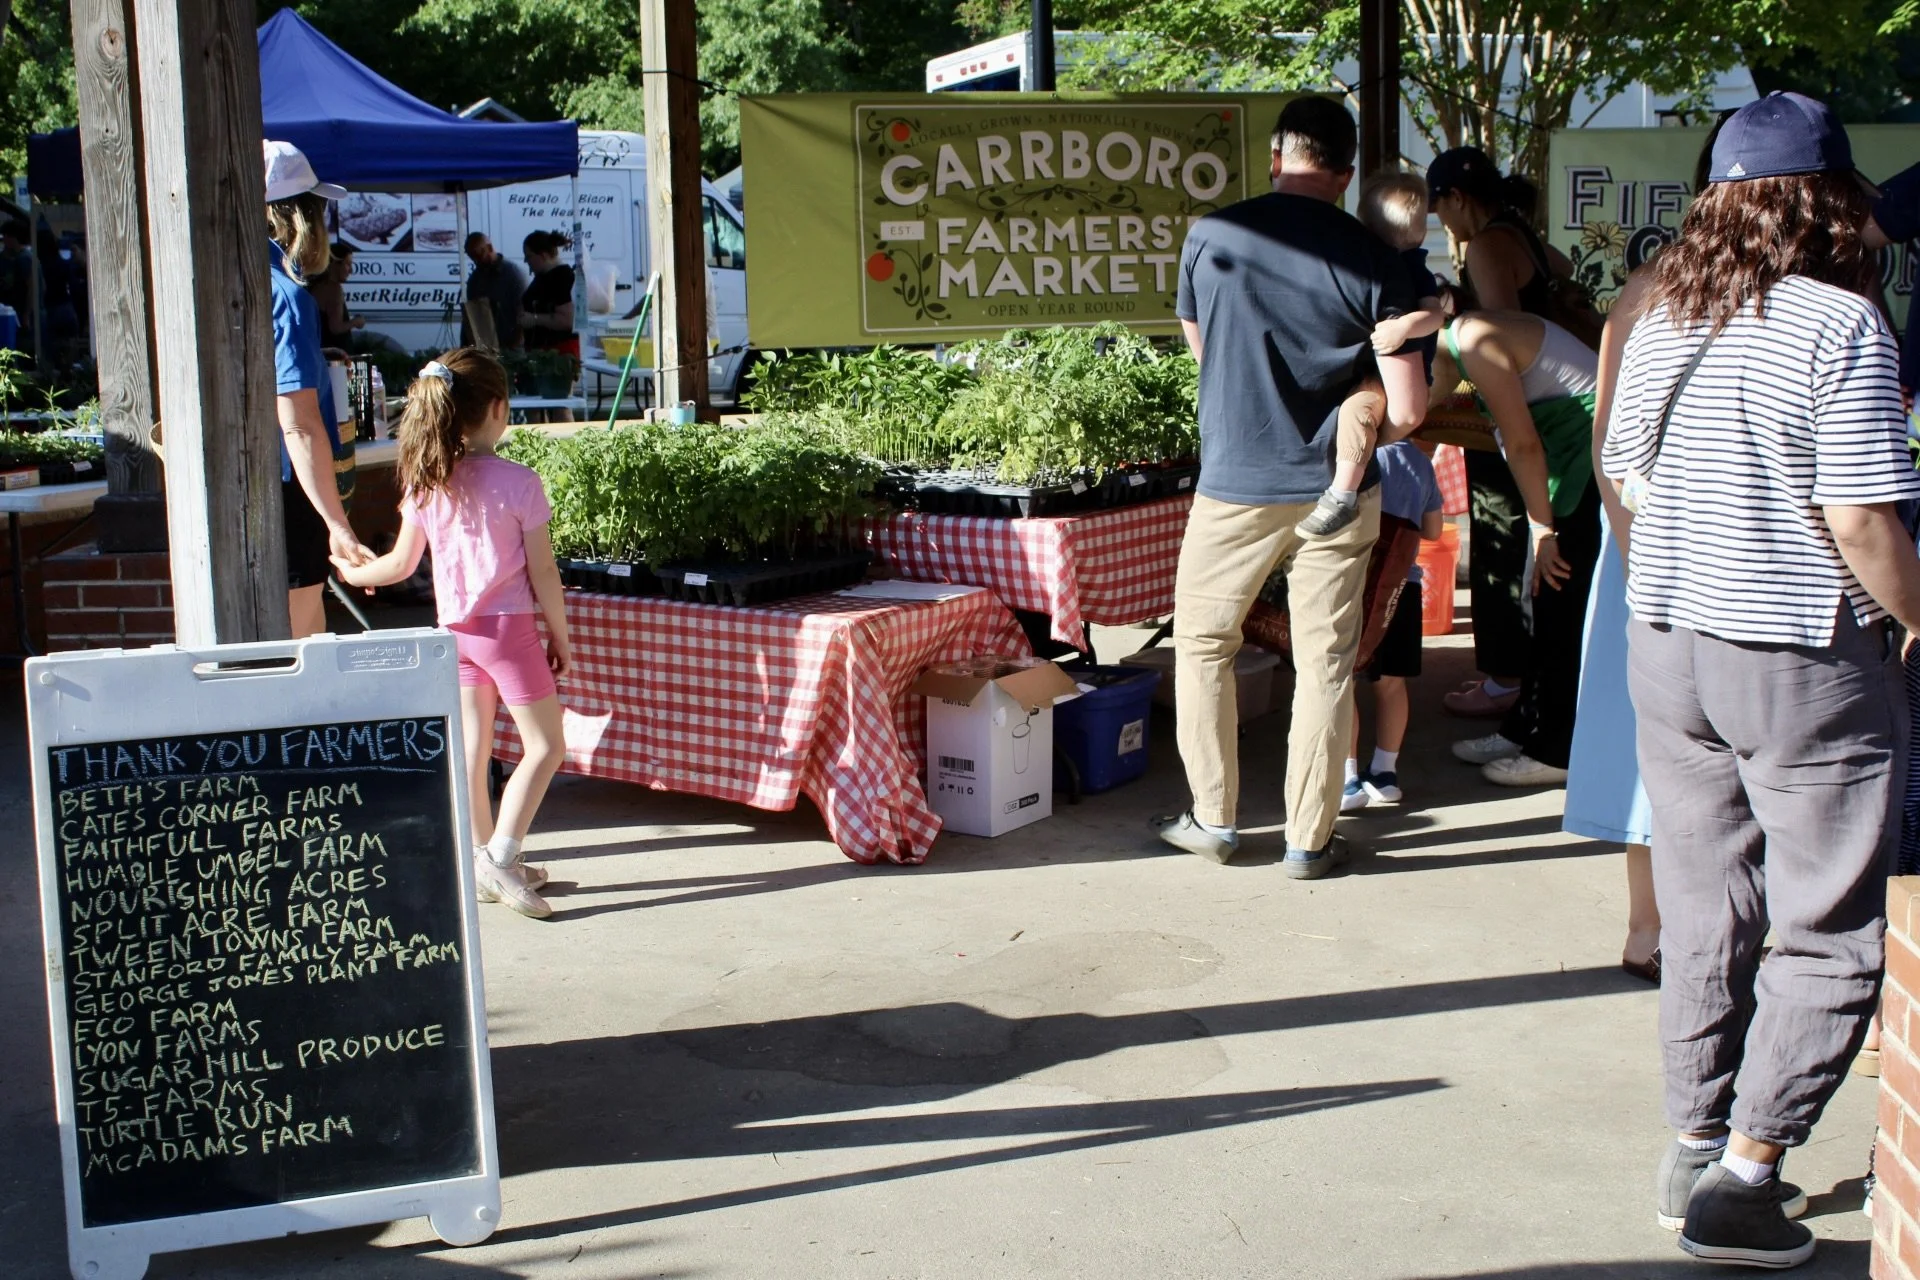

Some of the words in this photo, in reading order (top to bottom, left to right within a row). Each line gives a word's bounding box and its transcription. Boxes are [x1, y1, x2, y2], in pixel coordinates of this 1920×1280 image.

[910, 121, 973, 148] LOCALLY
[980, 114, 1032, 131] GROWN
[1049, 113, 1139, 129] NATIONALLY
[1144, 121, 1196, 146] KNOWN
[881, 130, 1227, 207] CARRBORO
[508, 193, 559, 204] Buffalo
[522, 207, 545, 217] The
[551, 207, 602, 219] Heathy
[1564, 166, 1692, 230] FIF
[890, 225, 916, 236] EST.
[938, 215, 1183, 254] FARMERS'
[350, 261, 386, 276] ORO,
[394, 262, 416, 275] NC
[938, 253, 1177, 298] MARKET
[988, 304, 1030, 317] OPEN
[1036, 302, 1077, 316] YEAR
[1084, 300, 1137, 314] ROUND
[52, 741, 187, 785] THANK
[196, 733, 267, 775] YOU
[280, 720, 445, 767] FARMERS
[59, 780, 168, 817] BETH'S
[180, 775, 260, 800] FARM
[60, 807, 146, 843] CATES
[159, 794, 270, 830] CORNER
[287, 782, 363, 814] FARM
[64, 828, 227, 867] FAITHFULL
[243, 813, 343, 848] FARMS
[66, 858, 181, 893] HUMBLE
[197, 844, 292, 880] UMBEL
[303, 832, 389, 870] FARM
[71, 875, 271, 923] NOURISHING
[288, 864, 387, 900] ACRES
[69, 933, 191, 972] TWEEN
[201, 929, 304, 955] TOWNS
[322, 916, 395, 944] FARM
[73, 914, 170, 949] SPLIT
[182, 906, 271, 938] ACRE
[288, 898, 370, 928] FARM
[73, 957, 226, 994] STANFORD
[239, 944, 343, 972] FAMILY
[353, 933, 430, 960] FARM
[74, 981, 193, 1016] GEORGE
[208, 966, 294, 992] JONES
[307, 953, 387, 984] PLANT
[396, 941, 460, 970] FARM
[74, 1017, 135, 1044] ECO
[151, 997, 238, 1032] FARM
[75, 1039, 141, 1070] LYON
[155, 1020, 262, 1060] FARMS
[79, 1059, 196, 1096] SUGAR
[205, 1049, 284, 1079] HILL
[298, 1024, 445, 1068] PRODUCE
[79, 1112, 198, 1150] TURTLE
[214, 1094, 293, 1135] RUN
[262, 1115, 353, 1154] FARM
